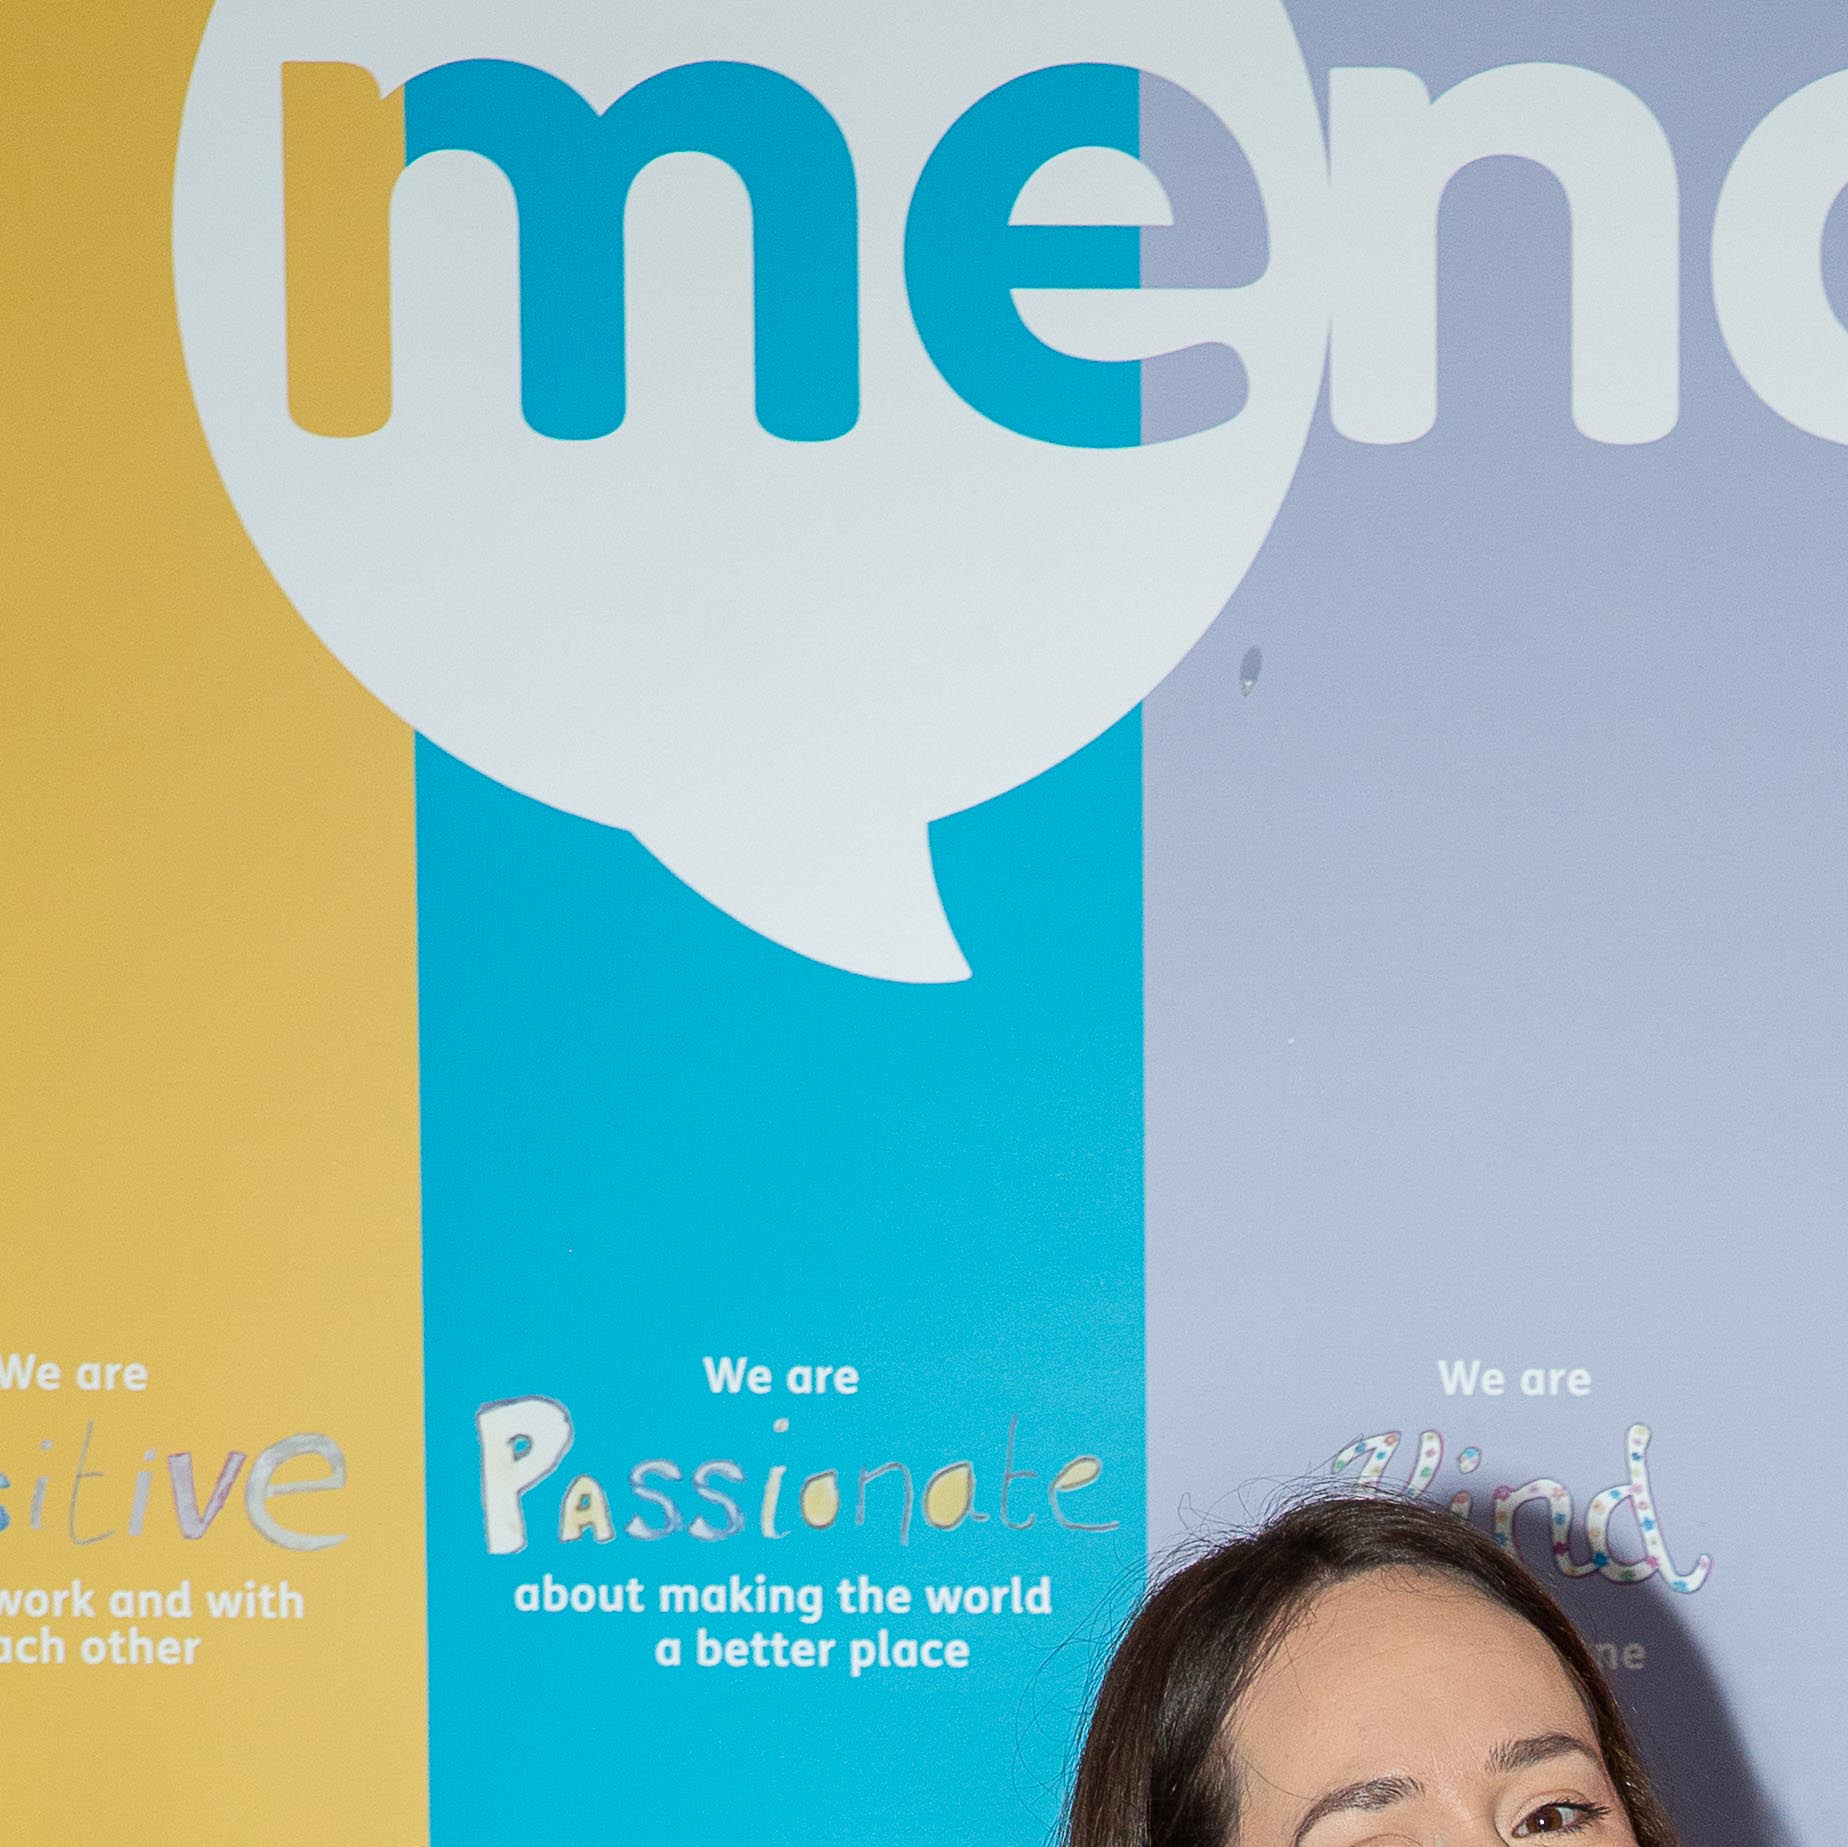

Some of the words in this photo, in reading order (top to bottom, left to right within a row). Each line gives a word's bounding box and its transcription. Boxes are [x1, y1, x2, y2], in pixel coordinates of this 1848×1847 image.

[0, 1353, 62, 1391] We
[76, 1362, 149, 1391] are
[702, 1356, 772, 1394] We
[786, 1364, 860, 1394] are
[1438, 1359, 1505, 1397] We
[1520, 1367, 1593, 1397] are
[108, 1580, 193, 1619] and
[206, 1581, 305, 1619] with
[513, 1574, 644, 1614] about
[659, 1575, 824, 1624] making
[837, 1577, 911, 1614] the
[925, 1577, 1052, 1615] world
[80, 1627, 201, 1666] other
[655, 1638, 682, 1667] a
[697, 1629, 837, 1667] better
[850, 1630, 970, 1678] place
